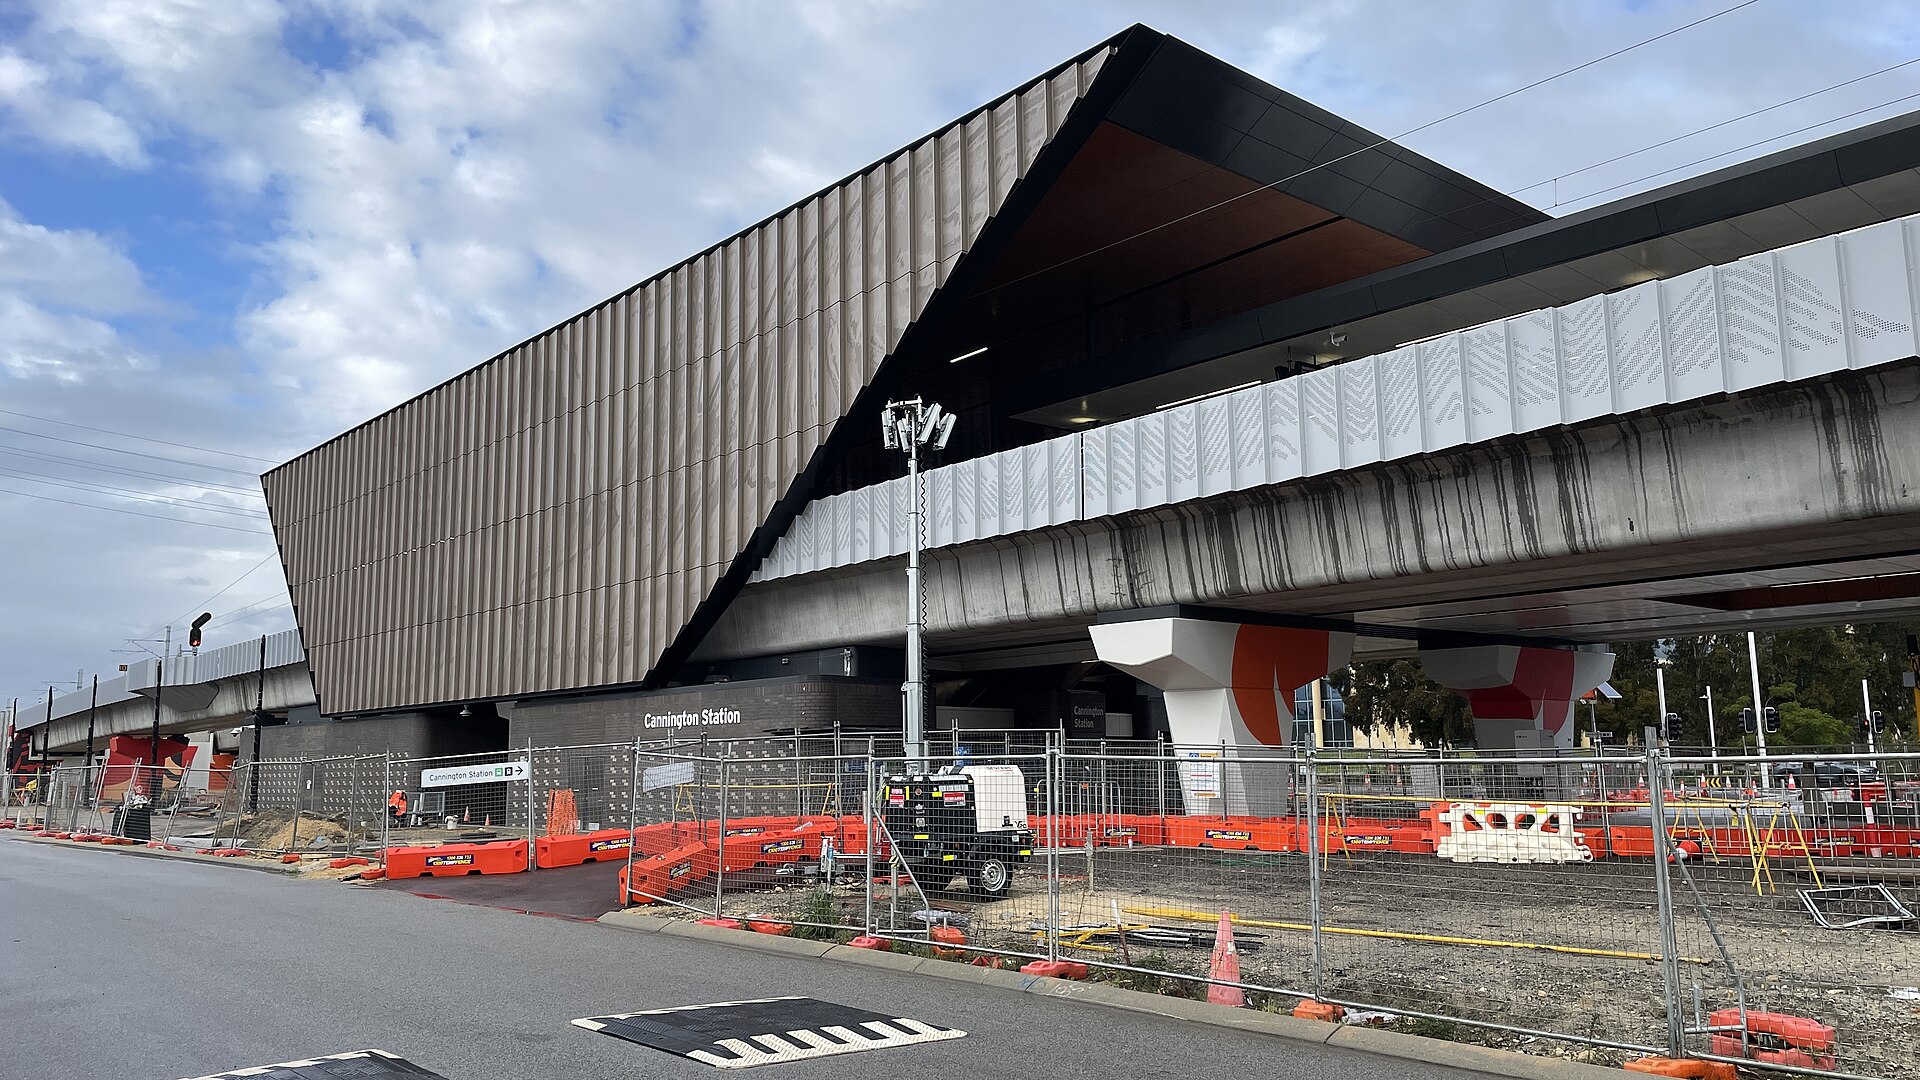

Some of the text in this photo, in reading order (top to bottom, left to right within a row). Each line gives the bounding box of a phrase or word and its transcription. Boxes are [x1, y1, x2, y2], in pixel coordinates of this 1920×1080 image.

[1073, 705, 1104, 718] Cannington
[644, 707, 741, 730] Cannington Station
[1074, 718, 1095, 728] Station
[429, 768, 494, 782] Cannington Station
